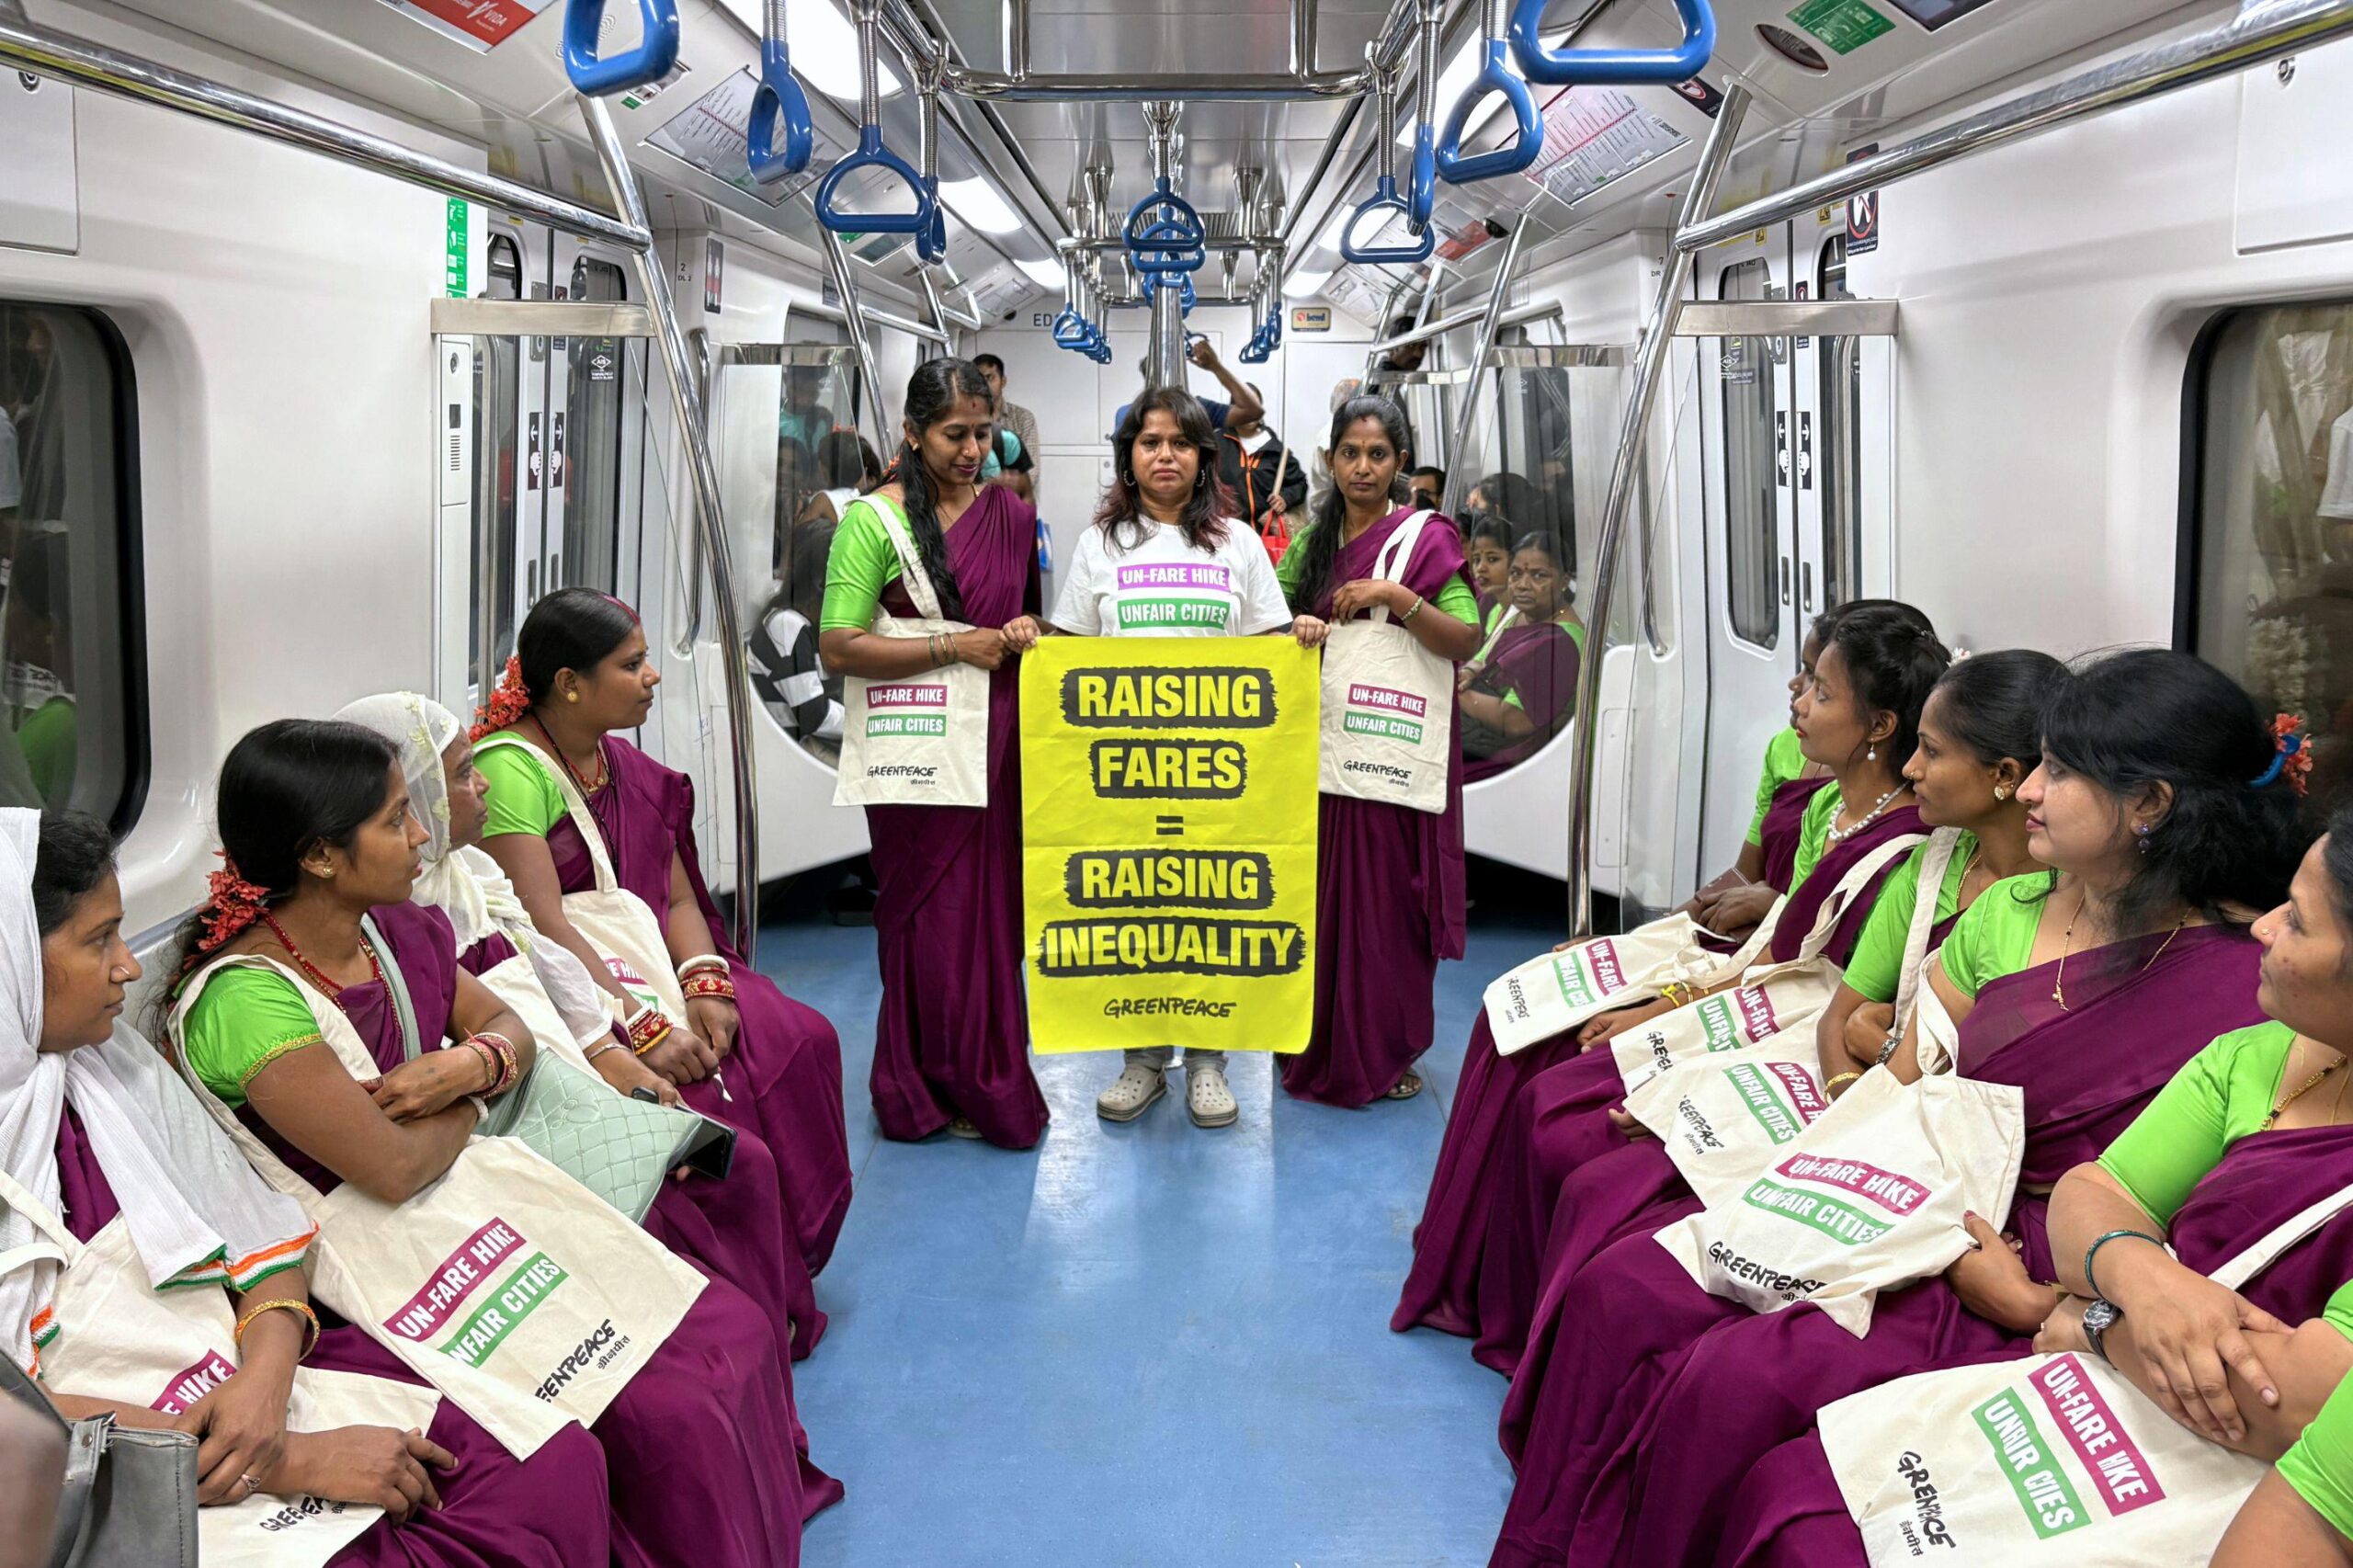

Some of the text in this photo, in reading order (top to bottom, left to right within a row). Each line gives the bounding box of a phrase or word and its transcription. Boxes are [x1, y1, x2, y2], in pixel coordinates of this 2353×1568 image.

[1658, 256, 1664, 265] 7
[1033, 313, 1060, 327] ED
[1122, 568, 1228, 586] UN-FARE HIKE
[1121, 604, 1227, 624] UNFAIR CITIES
[870, 688, 944, 704] UN-FARE HIKE
[1078, 675, 1260, 718] RAISING
[1353, 687, 1423, 713] UN-FARE HIKE
[868, 718, 943, 733] UNFAIR CITIES
[1347, 716, 1420, 740] UNFAIR CITIES
[867, 766, 938, 778] GREENPEACE
[1098, 747, 1241, 790] FARES
[1343, 760, 1412, 779] GREENPEACE
[1082, 857, 1258, 900] RAISING
[1046, 924, 1298, 969] INEQUALITY
[1592, 942, 1621, 991] UN-FAR
[1103, 997, 1237, 1018] GREENPEACE
[1741, 989, 1769, 1026] UN-FA
[1731, 1064, 1770, 1107] UNFAIR
[1759, 1106, 1795, 1141] CITIES
[1774, 1063, 1820, 1108] UN-FARE
[1678, 1096, 1724, 1148] REENPEACE
[1789, 1159, 1920, 1210] UN-FARE HIKE
[1750, 1185, 1885, 1243] UNFAIR CITIES
[395, 1223, 517, 1338] UN-FARE HIKE
[448, 1257, 561, 1363] NFAIR CITIES
[175, 1358, 233, 1404] HIKE
[535, 1318, 616, 1403] EENPEACE
[2043, 1362, 2149, 1503] UN-FARE HIKE
